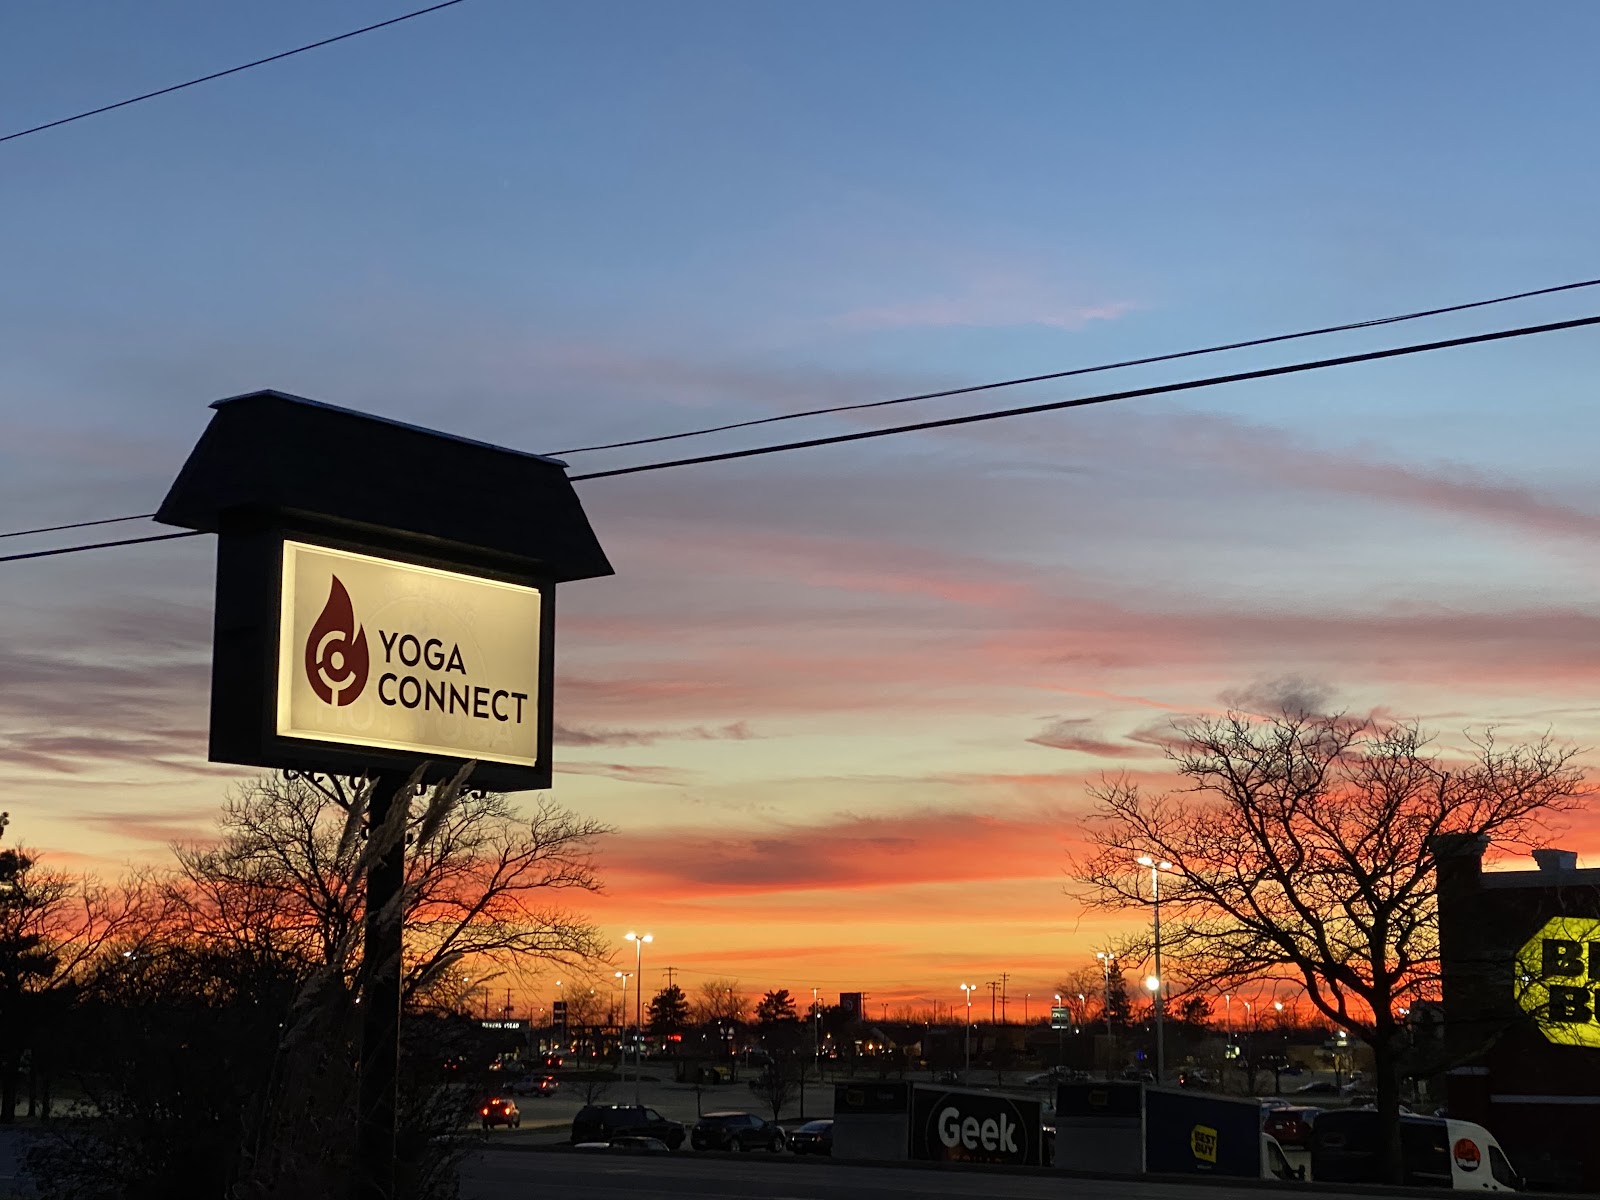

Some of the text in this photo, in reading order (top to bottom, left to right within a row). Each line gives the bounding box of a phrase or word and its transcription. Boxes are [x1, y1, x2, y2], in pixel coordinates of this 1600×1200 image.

[378, 630, 467, 675] YOGA
[378, 673, 528, 723] CONNECT
[1549, 985, 1600, 1023] B
[938, 1106, 1018, 1153] Geek
[1195, 1131, 1215, 1146] BEST
[1195, 1142, 1214, 1156] BUY
